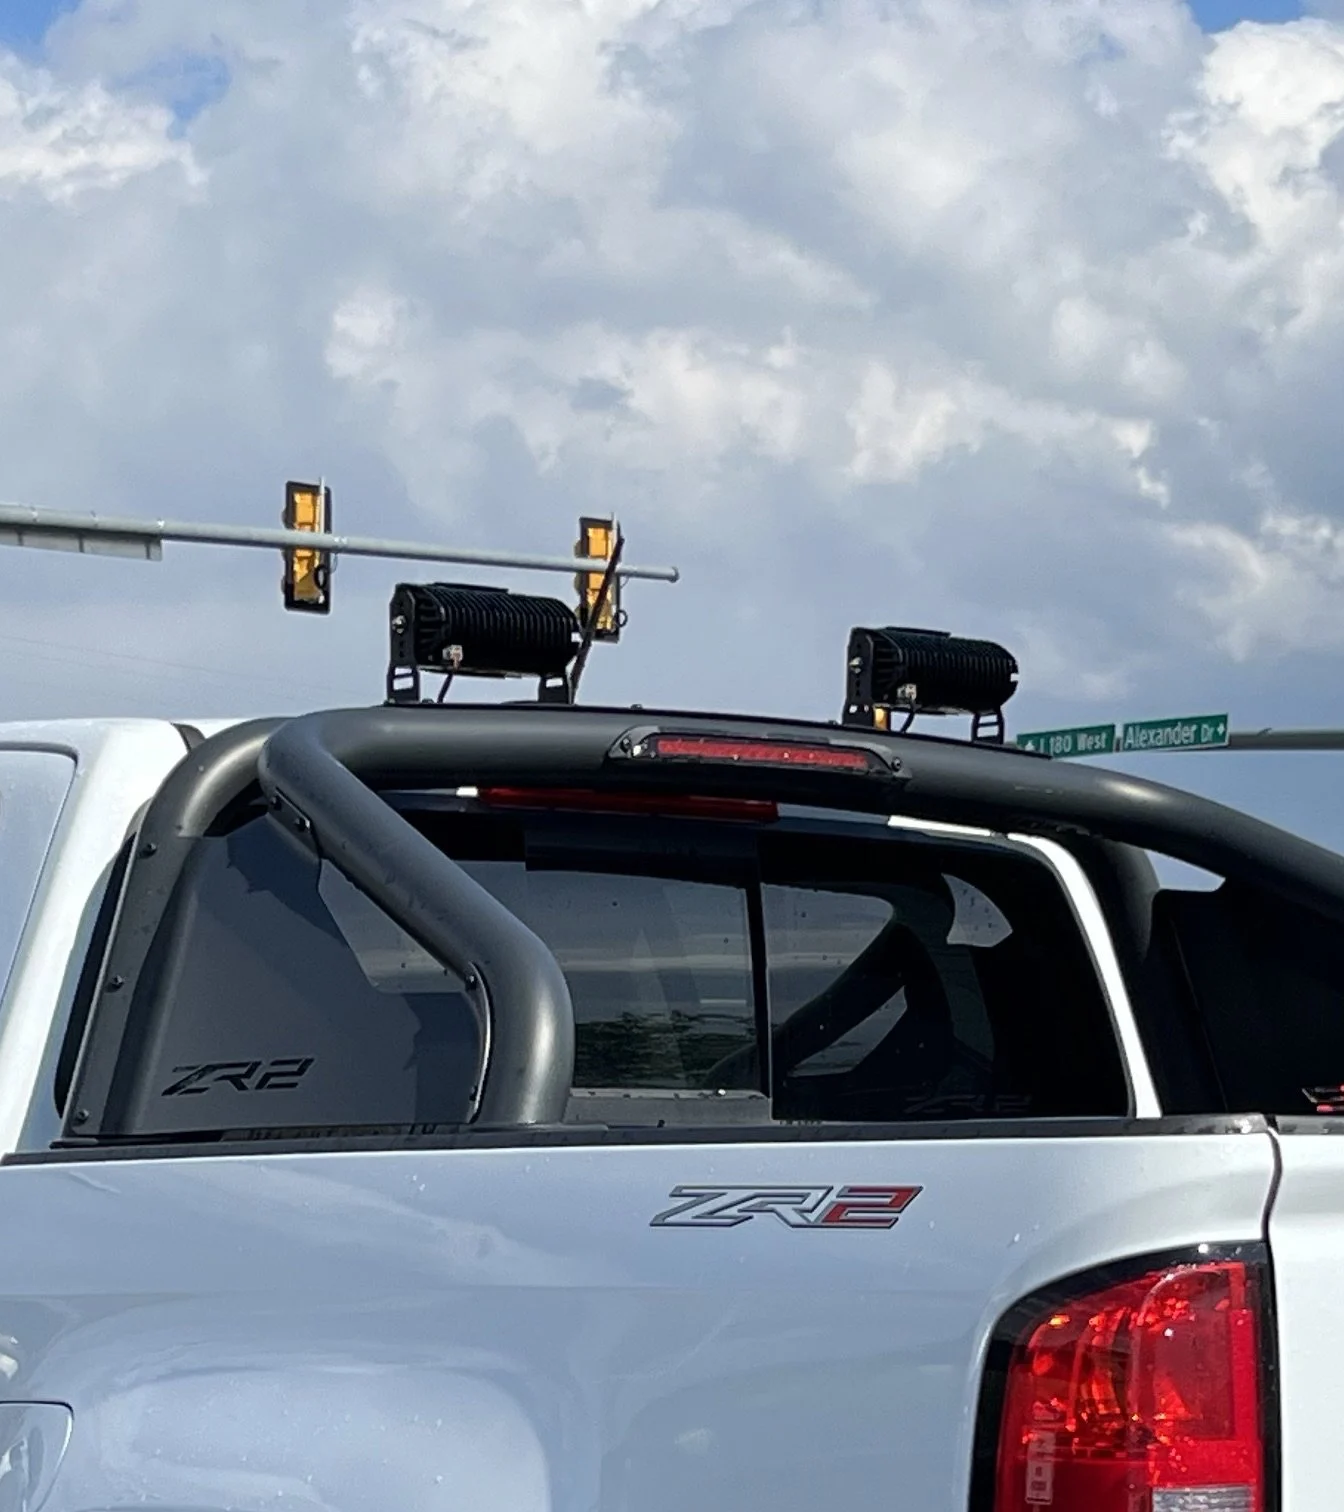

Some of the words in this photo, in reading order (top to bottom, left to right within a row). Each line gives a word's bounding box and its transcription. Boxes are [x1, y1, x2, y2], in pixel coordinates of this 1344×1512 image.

[1049, 735, 1072, 754] 180
[1077, 732, 1106, 751] West
[1124, 722, 1197, 749] Alexander
[1201, 724, 1215, 743] Dr
[161, 1058, 315, 1096] ZR2
[650, 1185, 923, 1229] ZR2
